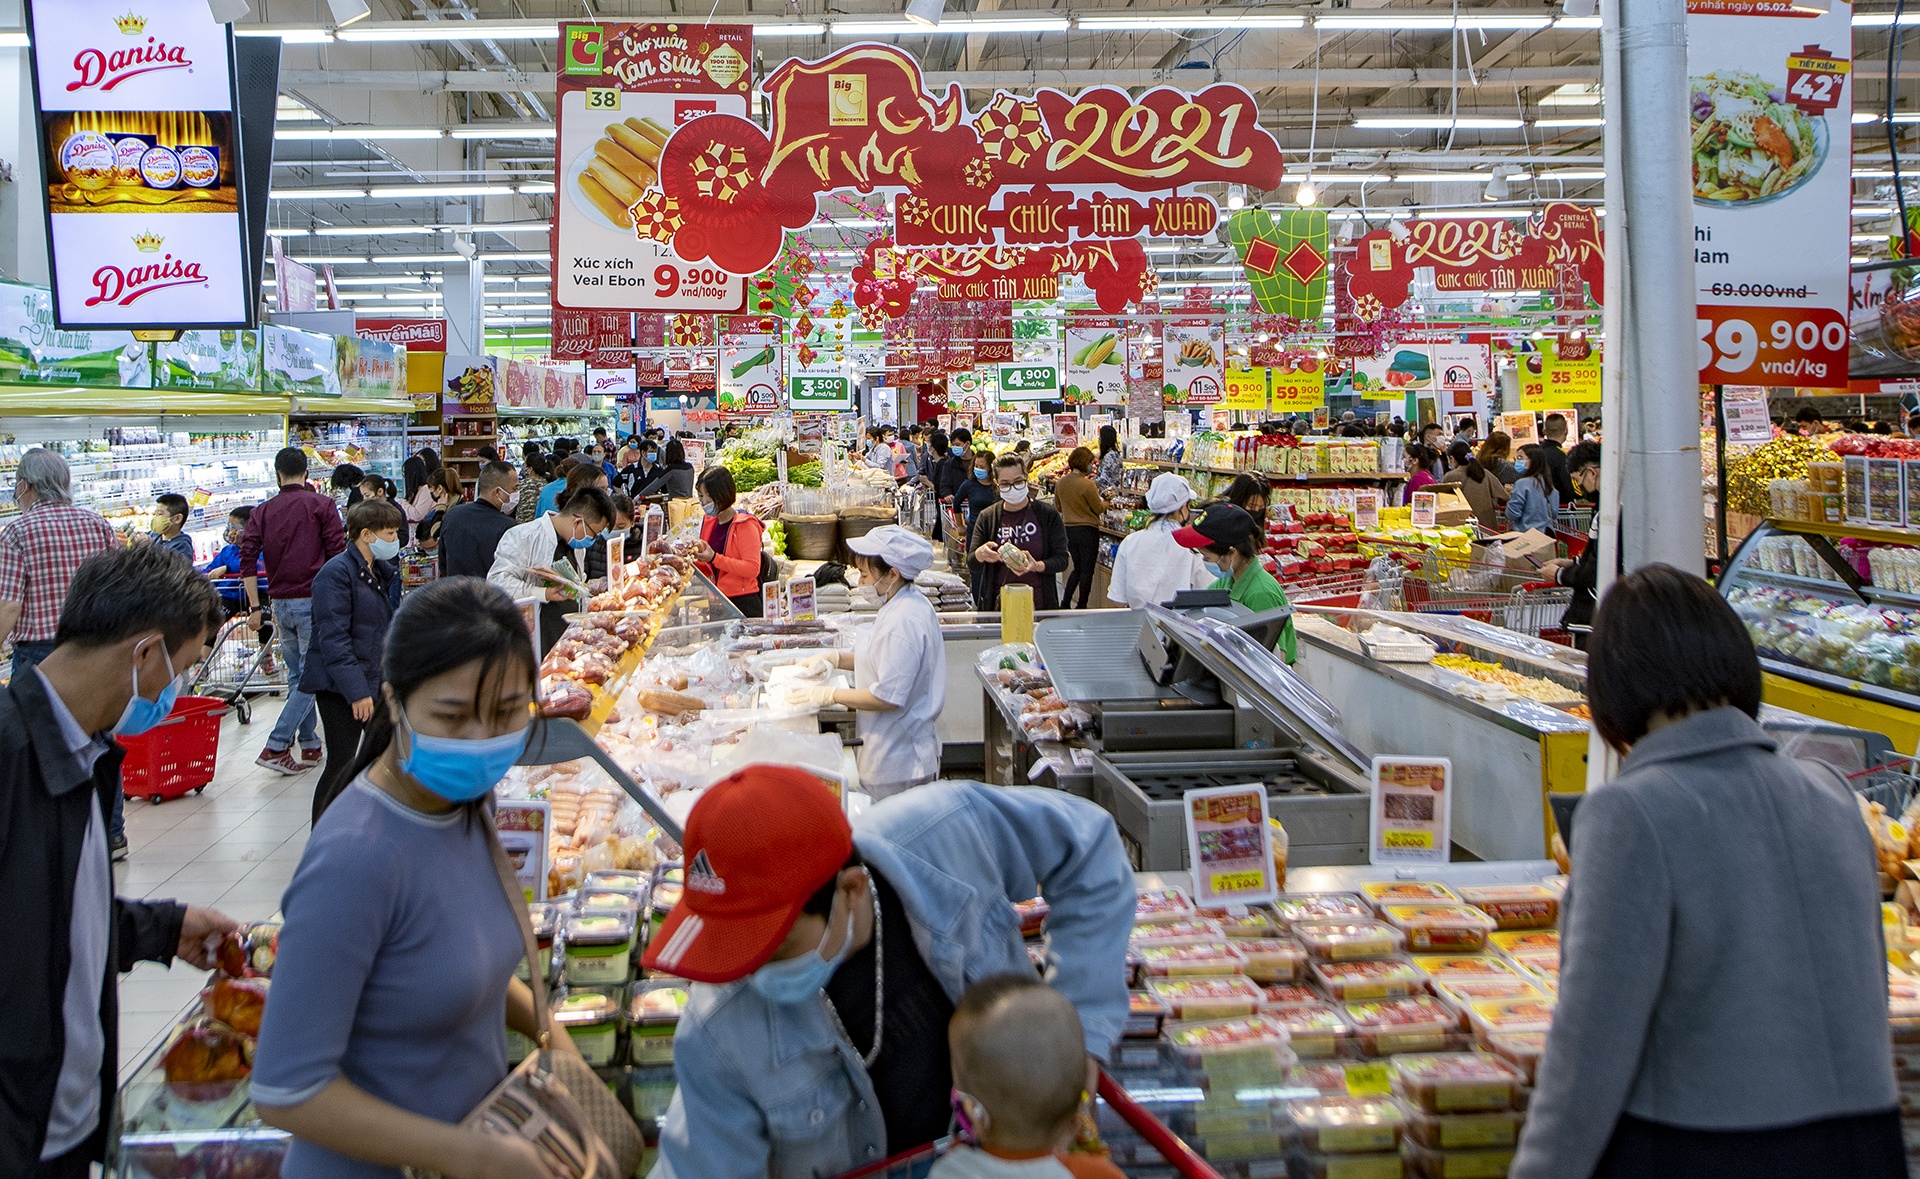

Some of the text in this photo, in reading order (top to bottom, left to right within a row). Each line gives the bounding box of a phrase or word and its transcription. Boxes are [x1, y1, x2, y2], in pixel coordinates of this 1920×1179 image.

[1728, 2, 1755, 12] ngày
[571, 31, 602, 65] Big C
[623, 33, 688, 57] Chợ xuân
[66, 36, 192, 92] Danisa
[613, 51, 702, 85] Tân Sửu
[1799, 58, 1837, 71] TIẾT KIỆM
[833, 79, 852, 90] Big
[590, 92, 616, 107] 38
[1046, 101, 1253, 177] 2021
[71, 141, 107, 157] Danisa
[931, 196, 1211, 234] CUNG CHÚC TÂN XUÂN
[1563, 221, 1586, 229] RETAIL
[1406, 220, 1510, 267] 2021
[573, 257, 633, 270] Xúc xích
[85, 254, 208, 306] Danisa
[573, 275, 645, 286] Veal Ebon
[1437, 264, 1556, 289] CUNG CHÚC TÂN XUÂN
[681, 286, 727, 300] vnd/100gr
[939, 275, 1058, 299] CUNG CHÚC TÂN XUÂN
[1711, 282, 1807, 299] 69.000vnd
[561, 316, 590, 336] XUÂN
[601, 314, 619, 330] TÂN
[557, 339, 597, 354] 2021
[600, 330, 625, 348] XUÂN
[596, 350, 629, 364] 2021
[979, 345, 1010, 358] 2021
[922, 365, 940, 376] 202
[1761, 358, 1827, 378] vnd/kg
[594, 376, 627, 390] Danisa
[638, 373, 662, 383] 2021
[1008, 369, 1050, 387] 4.900
[1276, 386, 1320, 399] 59.900
